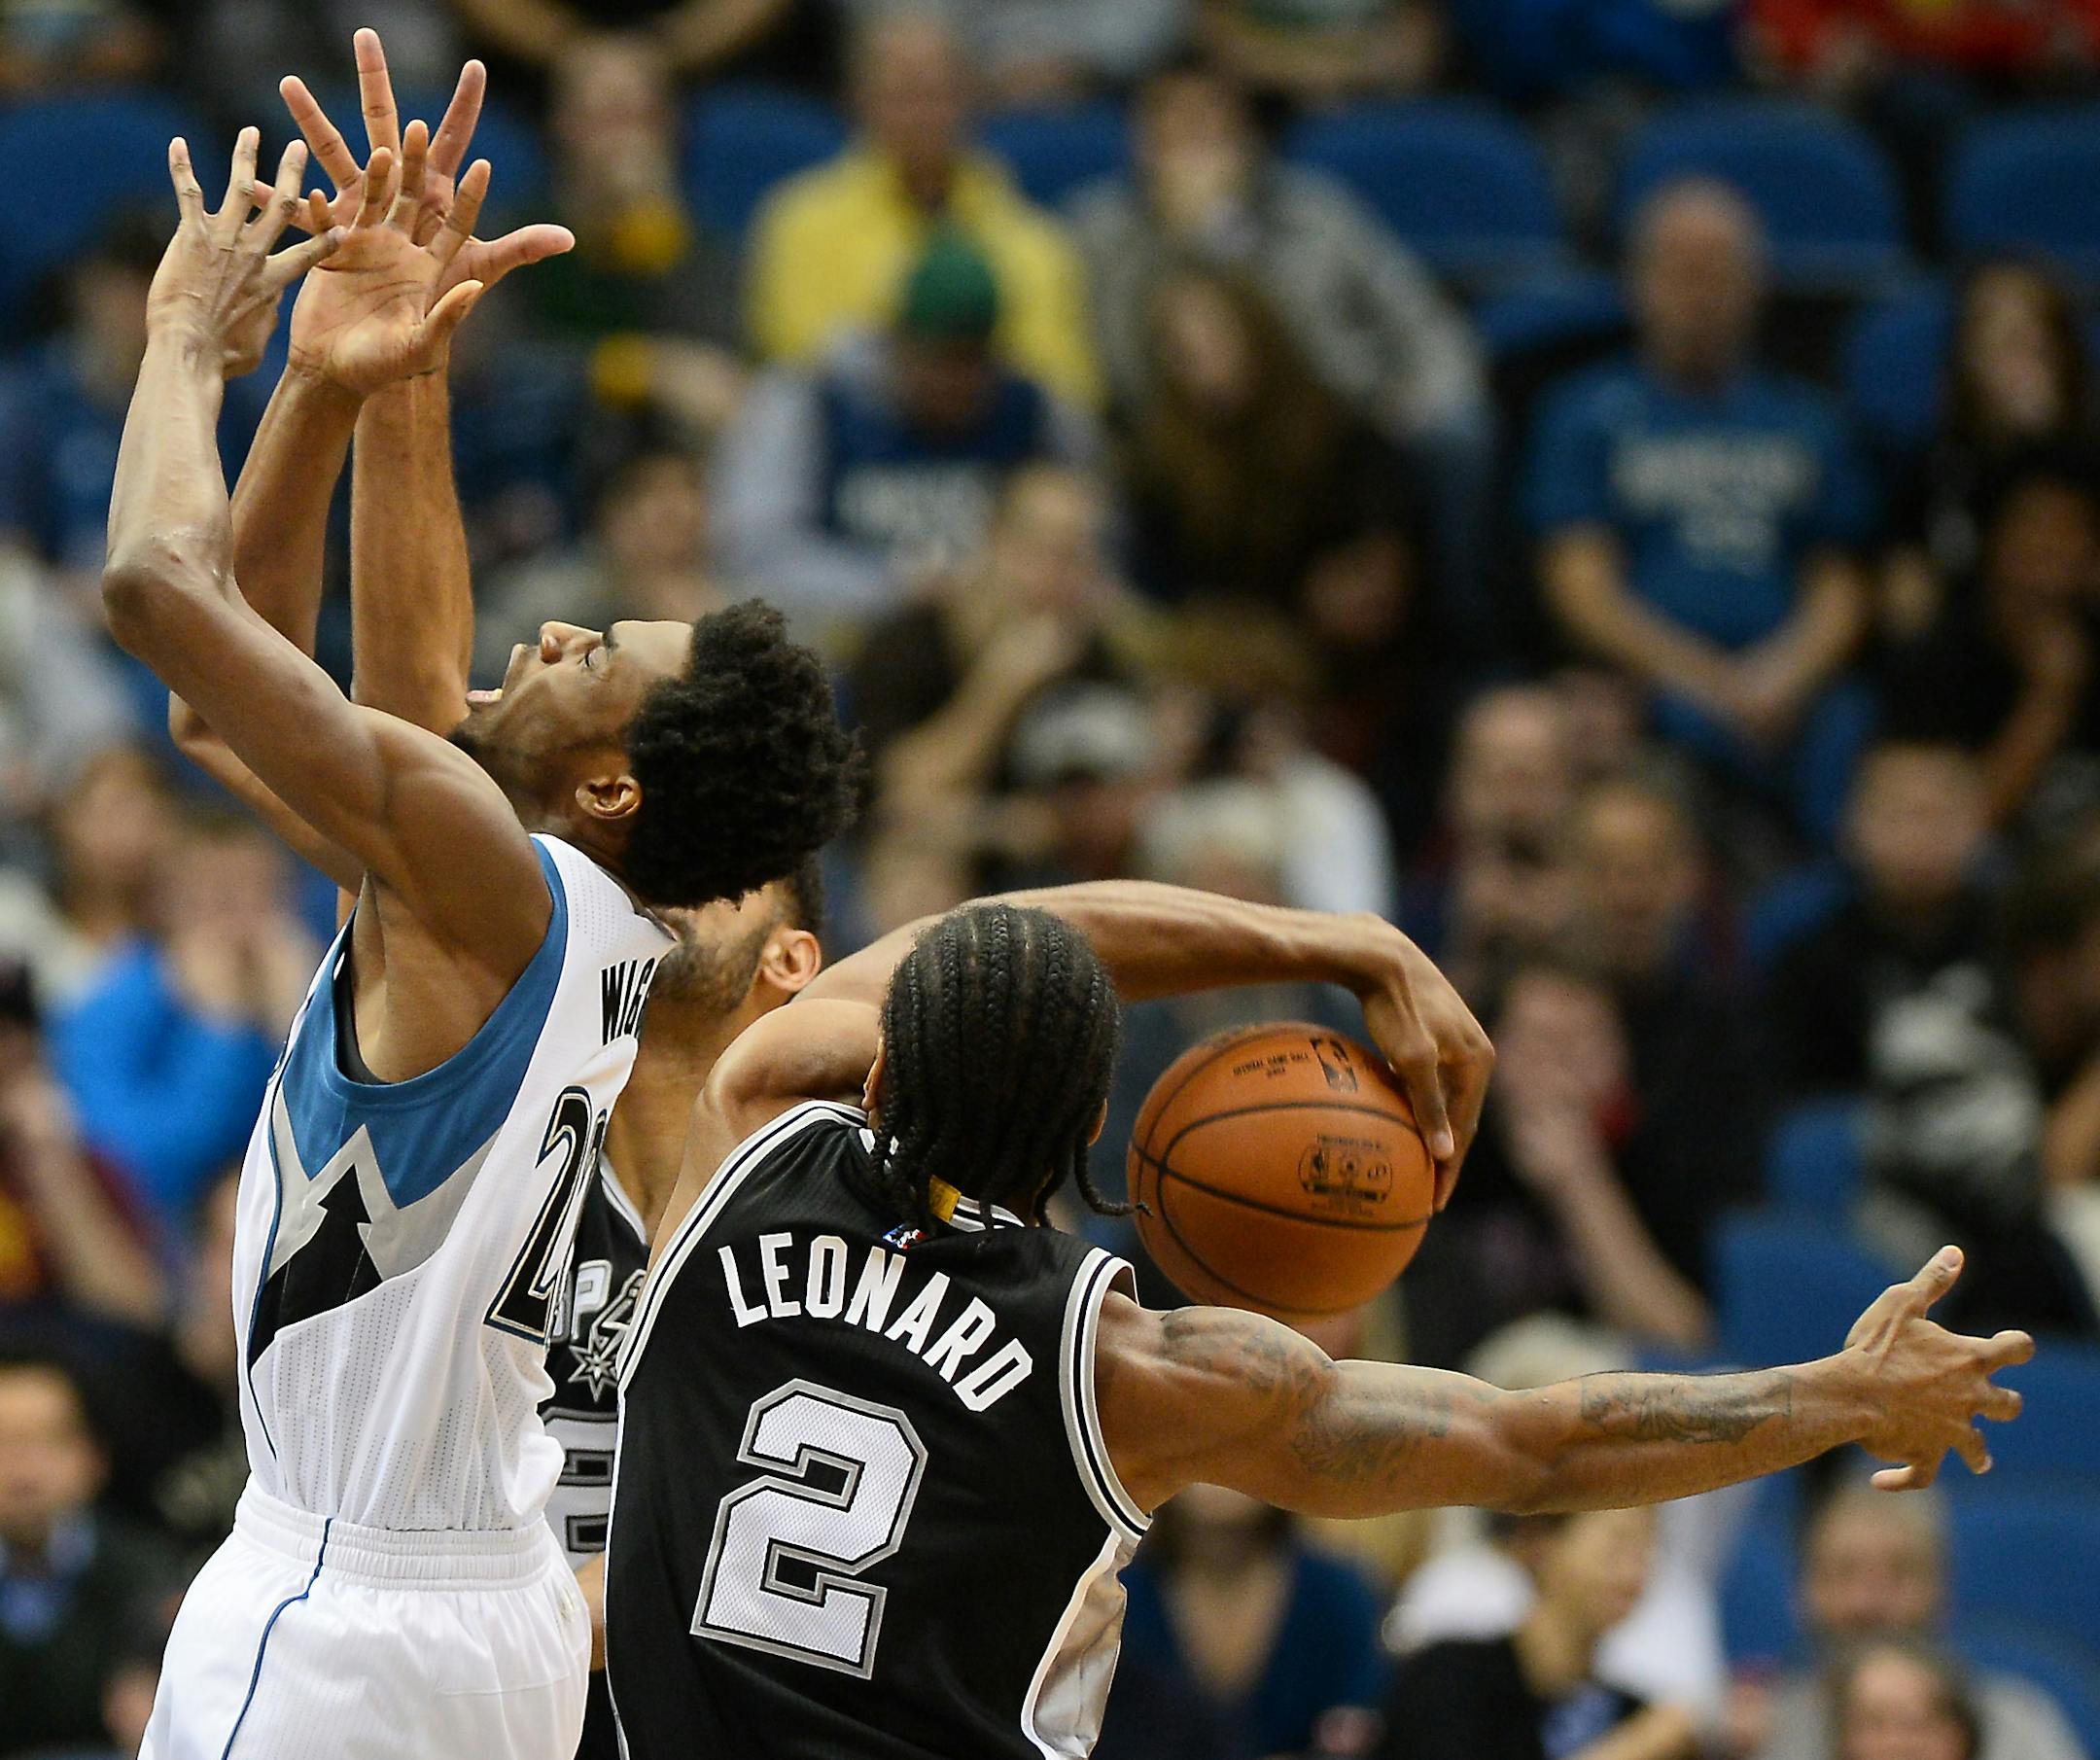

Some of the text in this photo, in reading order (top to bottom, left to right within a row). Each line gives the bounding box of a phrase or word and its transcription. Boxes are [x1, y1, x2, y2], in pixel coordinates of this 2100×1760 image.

[600, 958, 656, 1047] WIG
[718, 1232, 1032, 1412] LEONARD
[689, 1378, 928, 1680] 2
